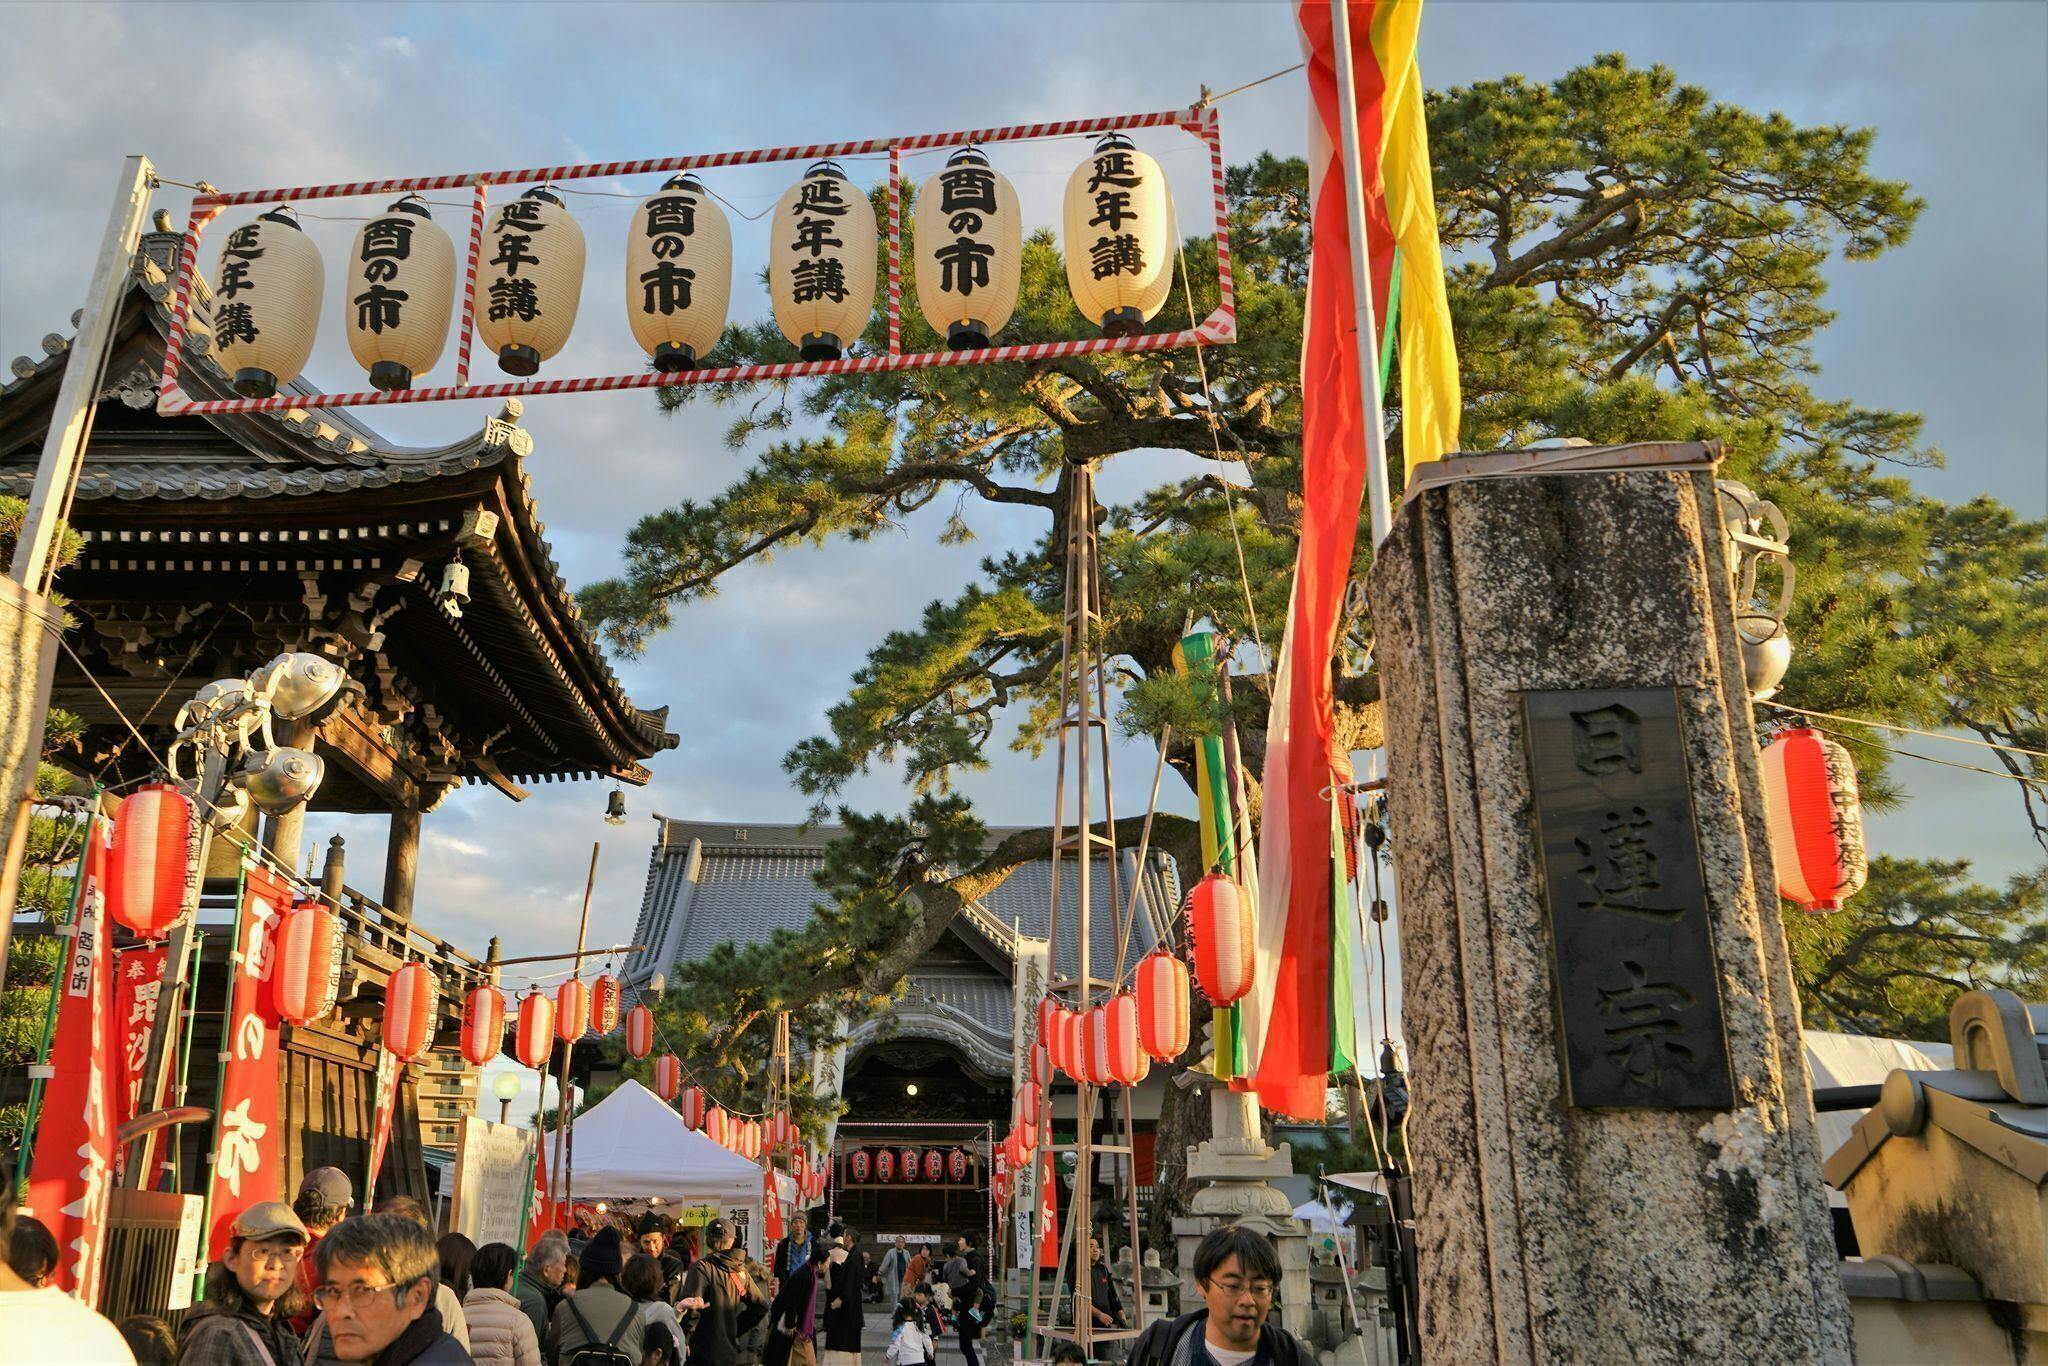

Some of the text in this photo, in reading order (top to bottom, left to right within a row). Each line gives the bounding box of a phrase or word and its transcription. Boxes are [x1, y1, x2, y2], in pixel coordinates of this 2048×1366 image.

[346, 218, 416, 334] 酉の市
[488, 200, 547, 322] 延年講
[640, 195, 697, 316] 酉の市
[791, 178, 851, 304] 延年講
[934, 168, 996, 296] 酉の市
[1088, 152, 1146, 281] 延年講
[213, 223, 266, 352] 延年講
[1570, 704, 1696, 1088] 日蓮宗
